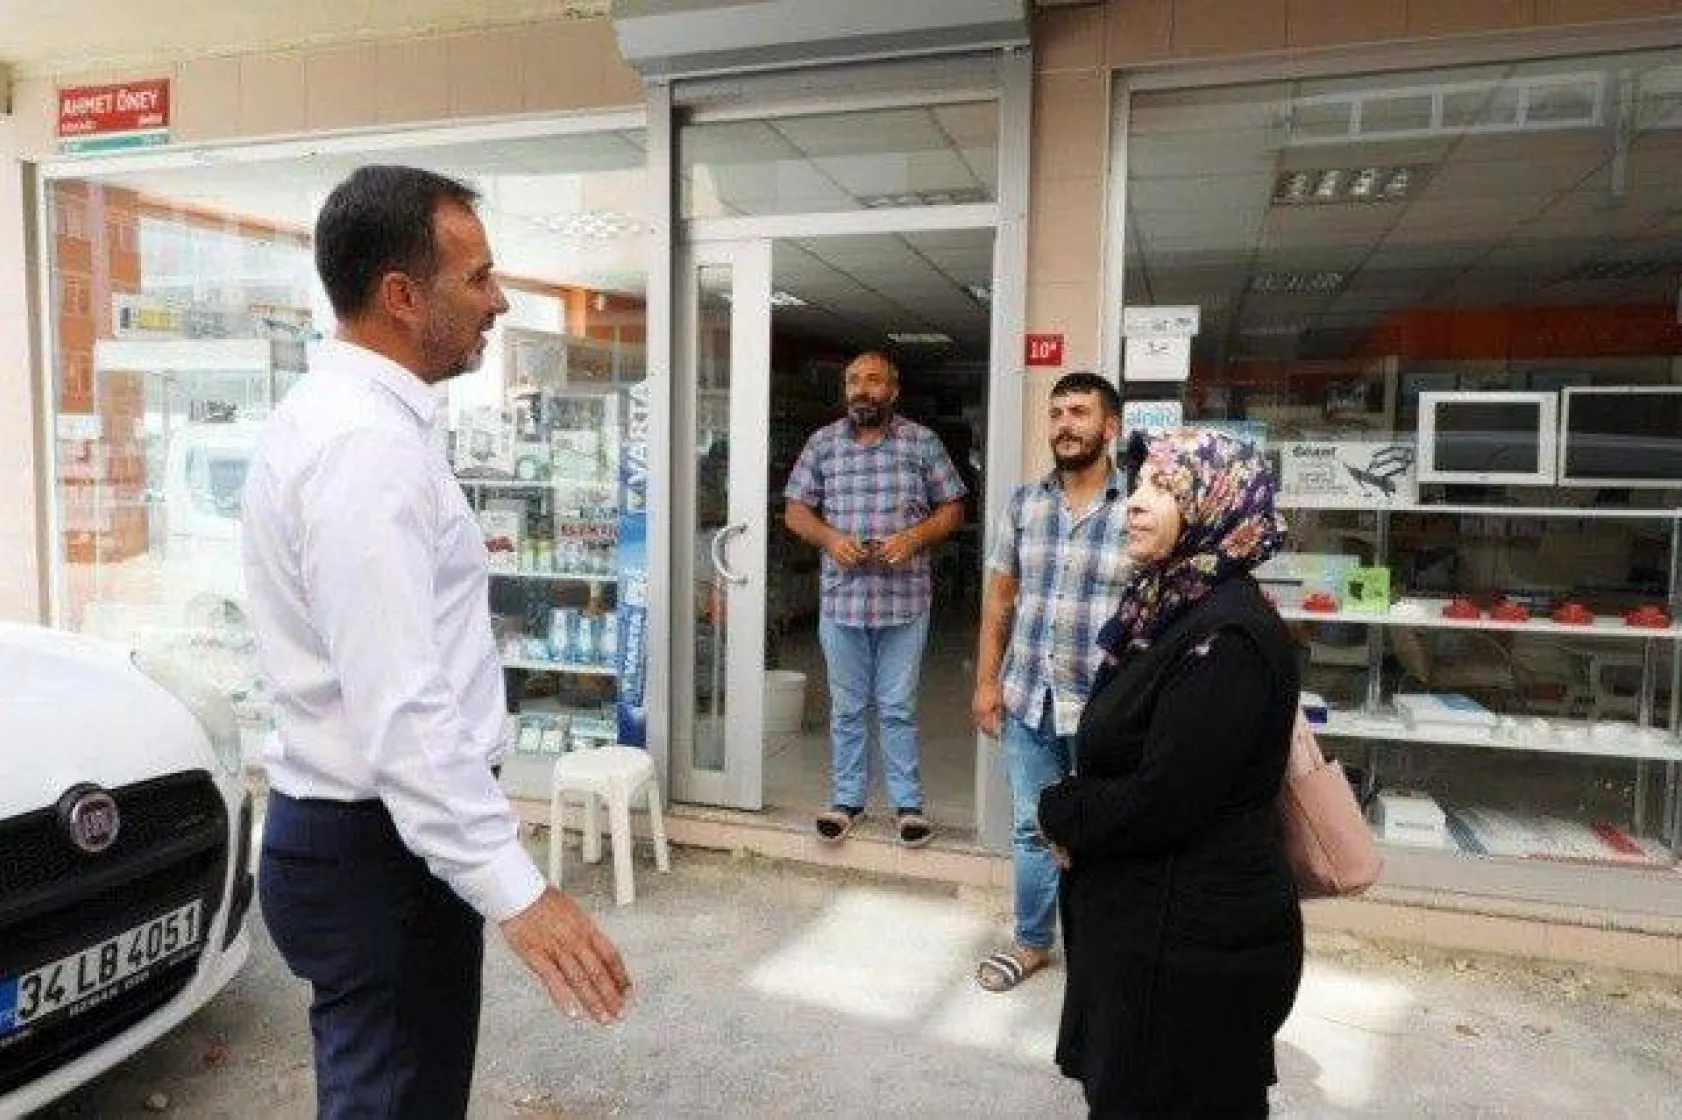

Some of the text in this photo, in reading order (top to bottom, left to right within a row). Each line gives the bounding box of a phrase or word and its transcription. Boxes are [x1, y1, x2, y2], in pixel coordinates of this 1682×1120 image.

[63, 94, 113, 116] AHMET
[628, 382, 650, 485] VARTA
[18, 963, 66, 1019] 34
[77, 941, 118, 995] LB
[127, 906, 197, 966] 4051
